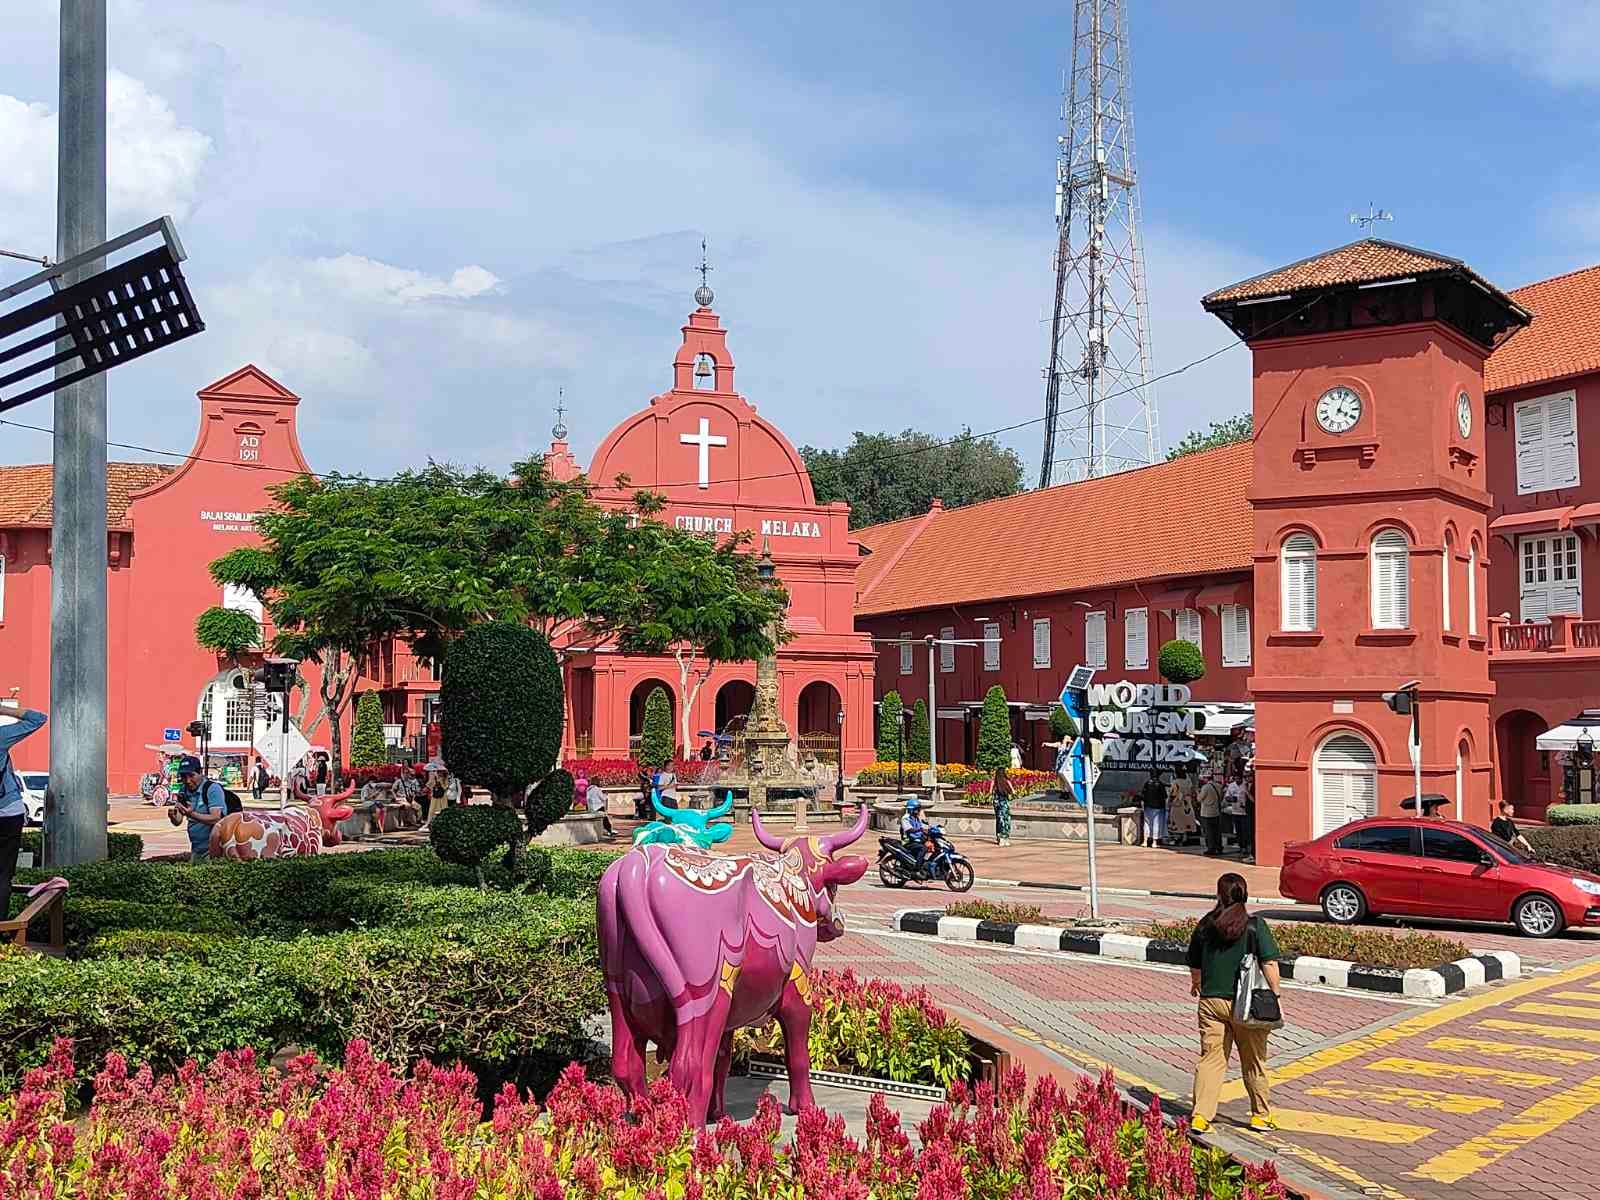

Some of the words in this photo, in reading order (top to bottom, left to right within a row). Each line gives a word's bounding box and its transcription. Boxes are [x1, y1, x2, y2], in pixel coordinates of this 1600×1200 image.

[240, 437, 259, 447] AD
[200, 511, 223, 520] BALAI
[675, 515, 732, 533] CHURCH
[761, 519, 821, 538] MELAKA
[1087, 680, 1192, 708] WORLD
[1088, 710, 1194, 734] TOURISM
[1135, 738, 1197, 762] 2025
